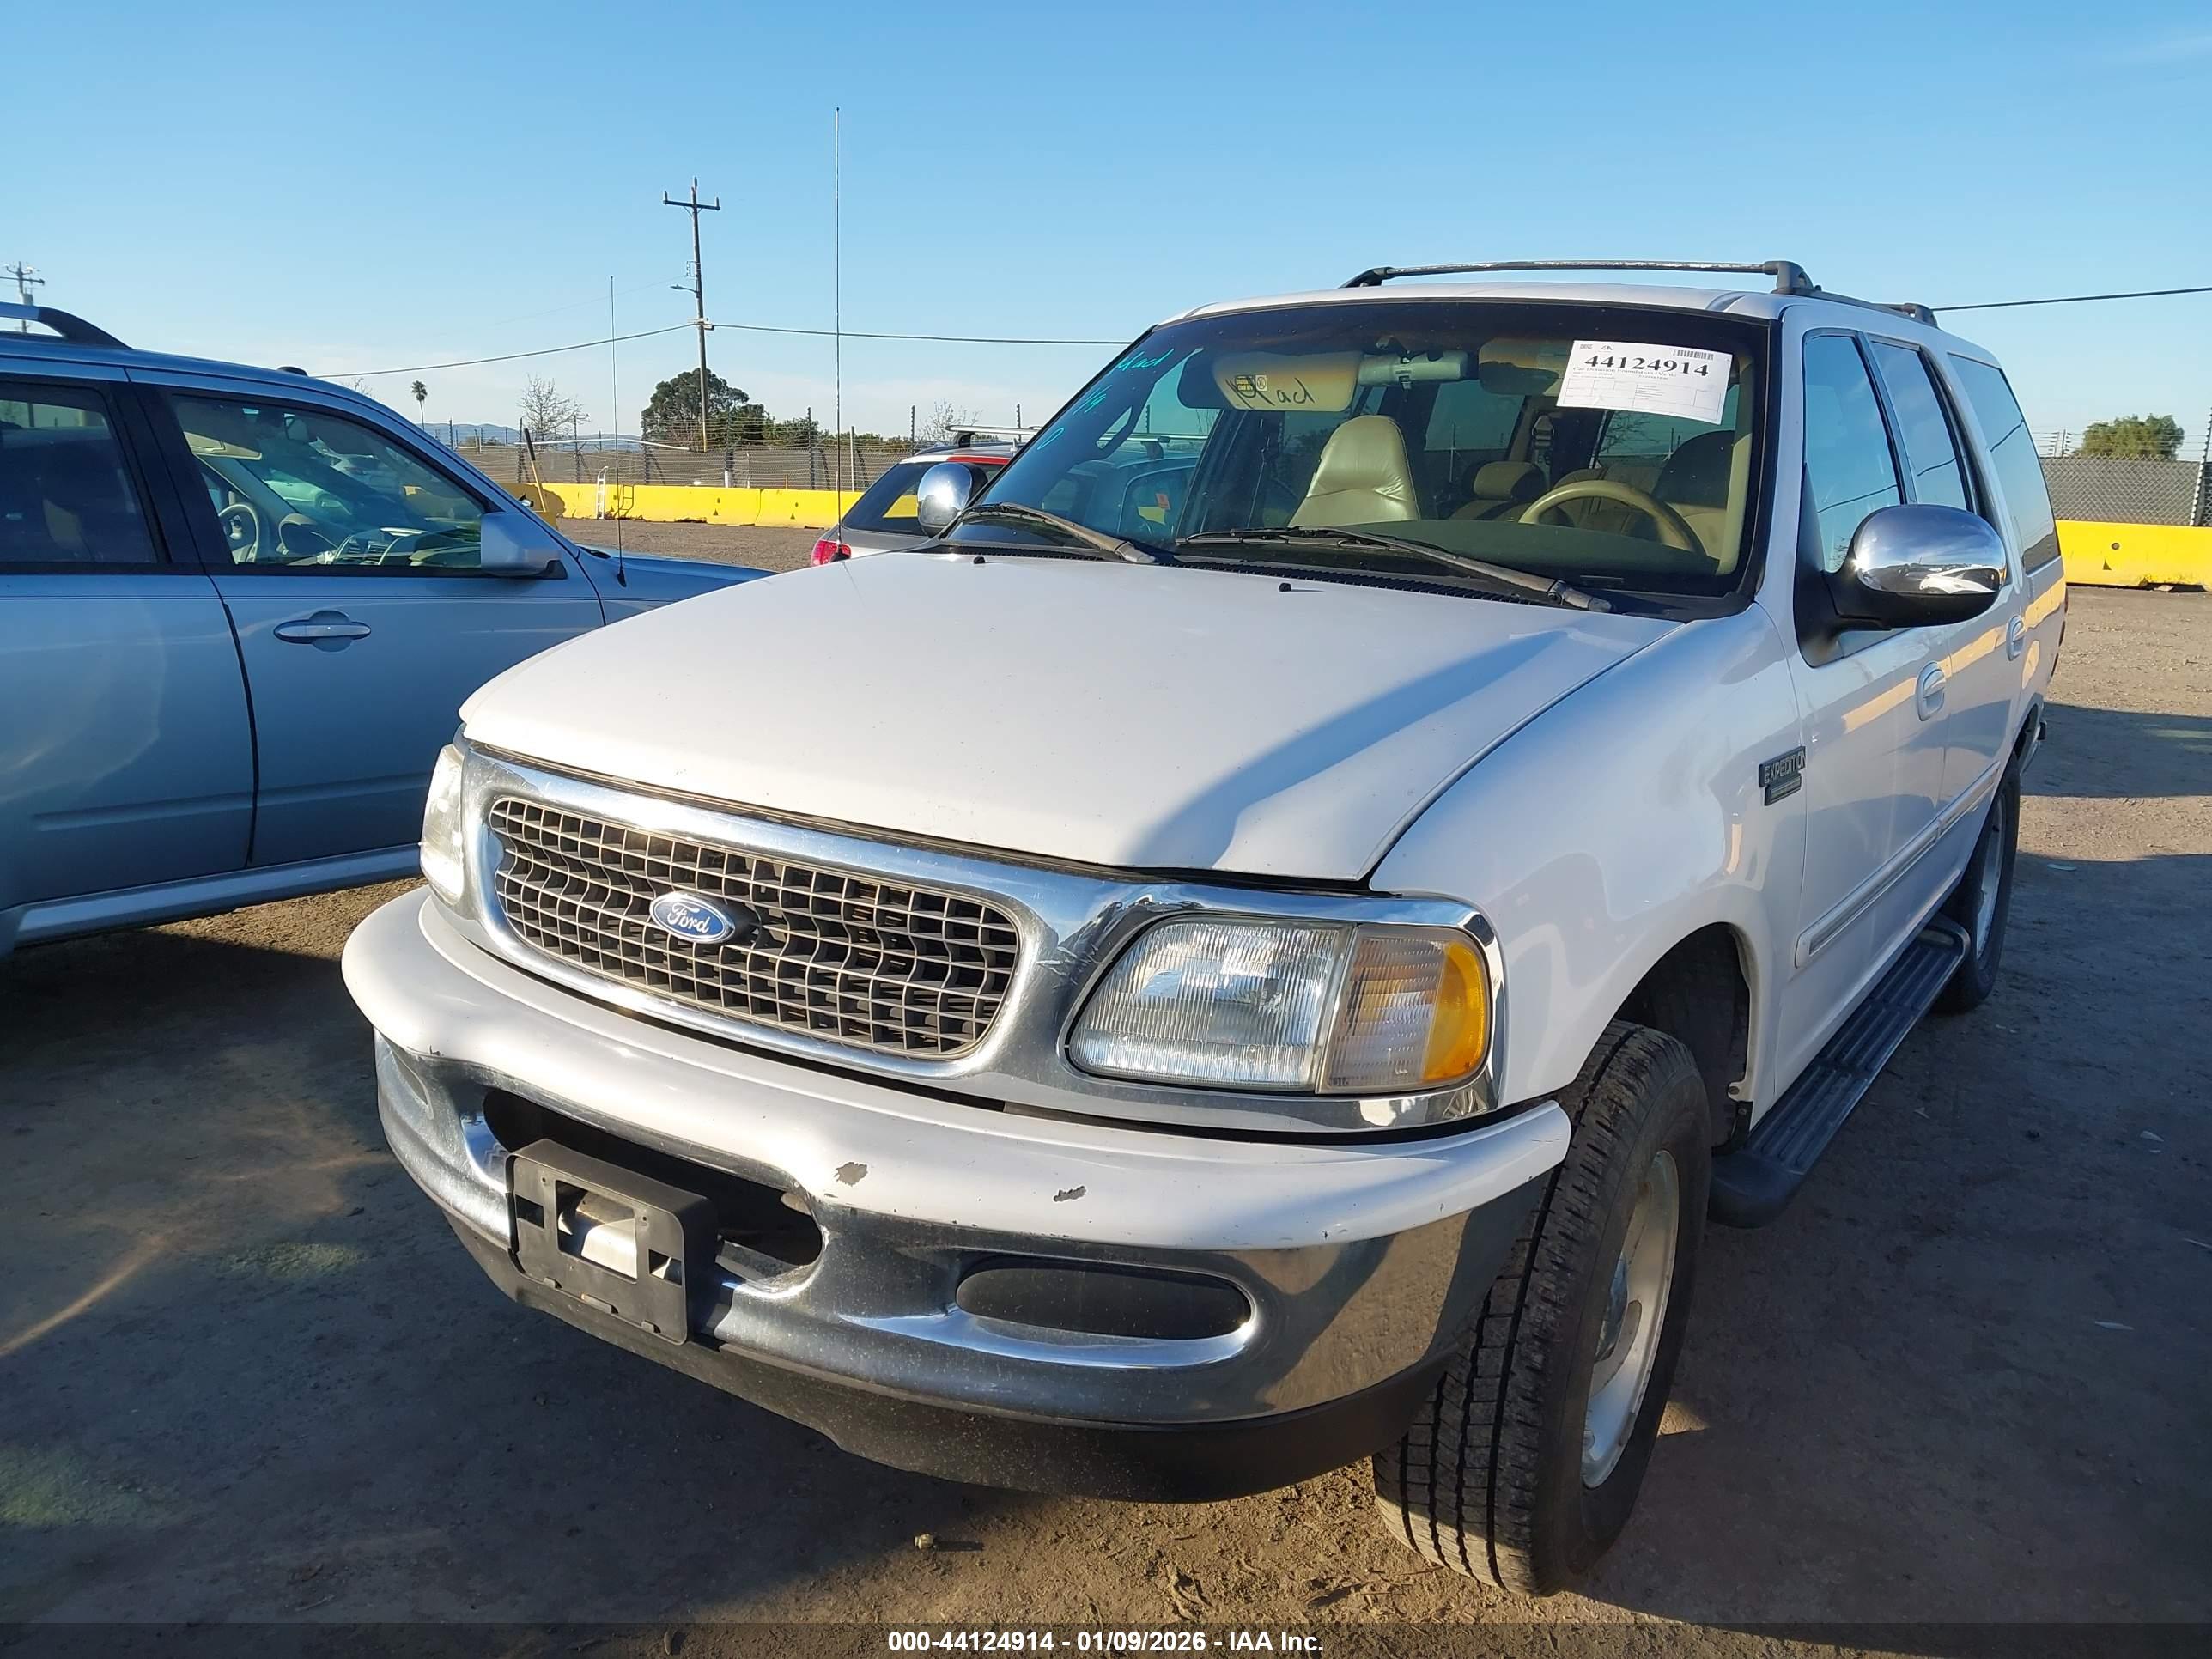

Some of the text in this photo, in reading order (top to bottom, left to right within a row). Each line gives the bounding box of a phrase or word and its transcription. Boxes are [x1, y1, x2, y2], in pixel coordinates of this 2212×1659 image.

[1584, 355, 1709, 377] 44124914
[1764, 750, 1806, 784] EXPEDITION
[667, 902, 710, 933] Ford
